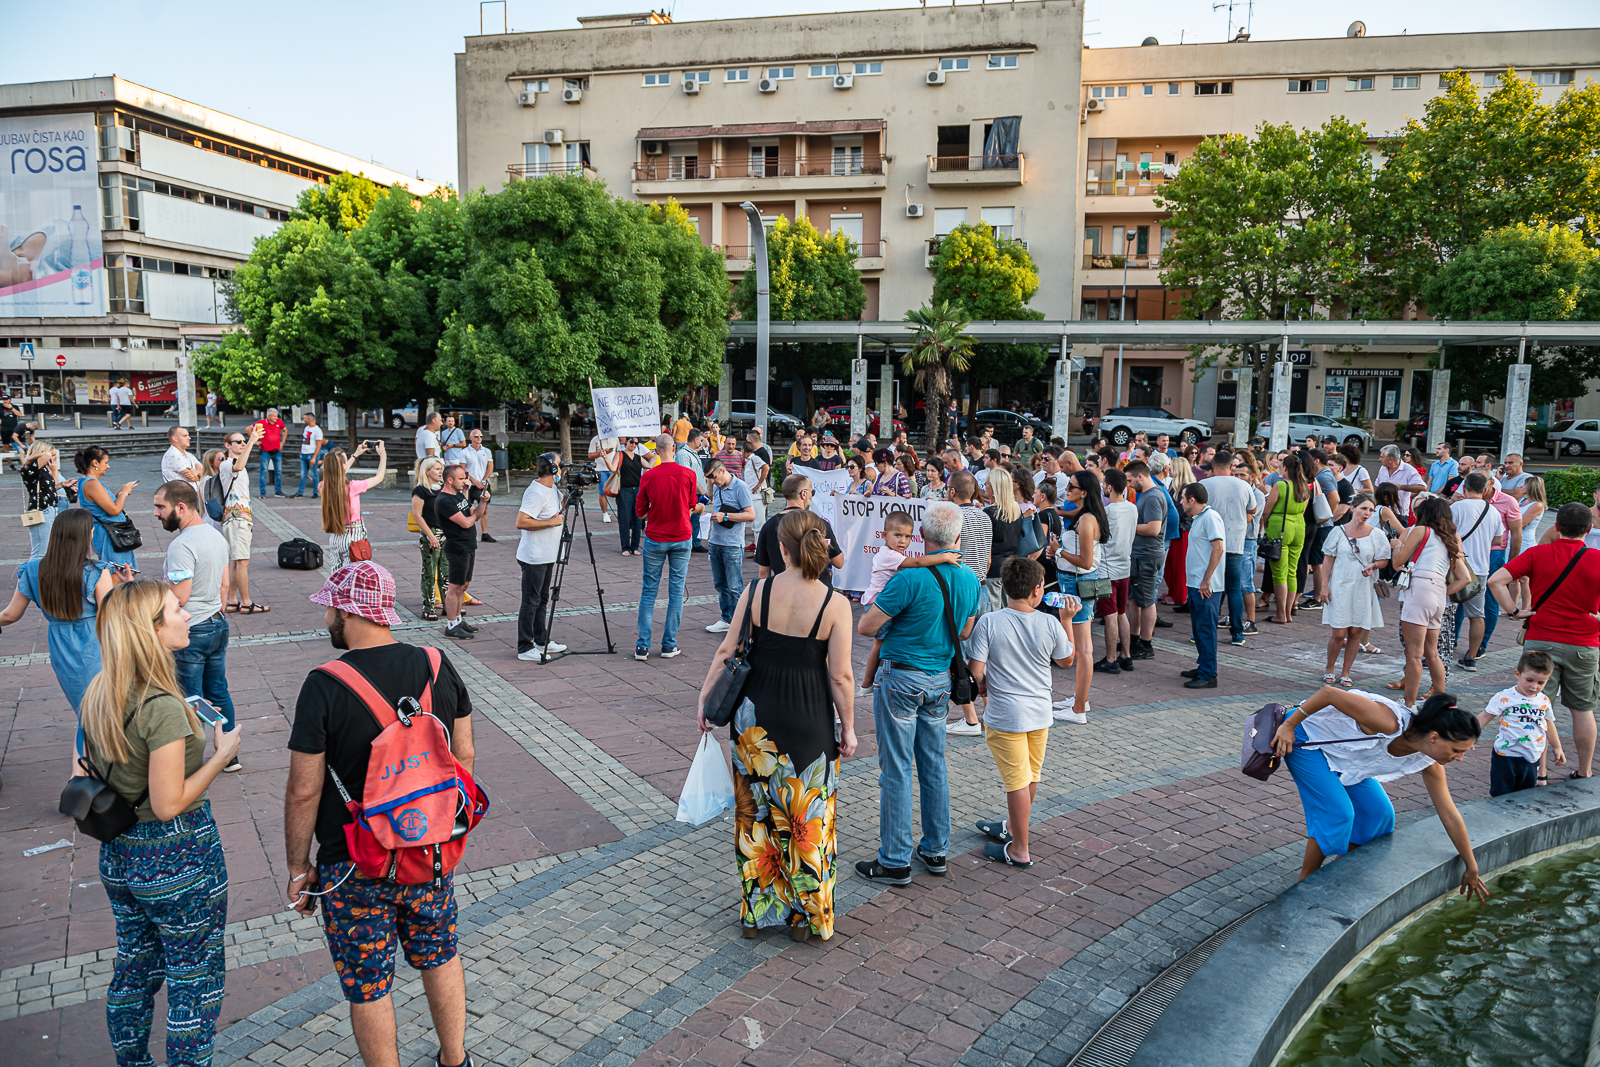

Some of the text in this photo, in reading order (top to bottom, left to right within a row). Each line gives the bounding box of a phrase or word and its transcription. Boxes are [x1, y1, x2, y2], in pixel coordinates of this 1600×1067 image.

[32, 130, 62, 144] ČISTA
[63, 129, 85, 142] KAO
[11, 145, 86, 174] rosa
[598, 393, 653, 408] NE OBAVEZNA
[842, 499, 875, 518] STOP
[381, 750, 432, 781] JUST
